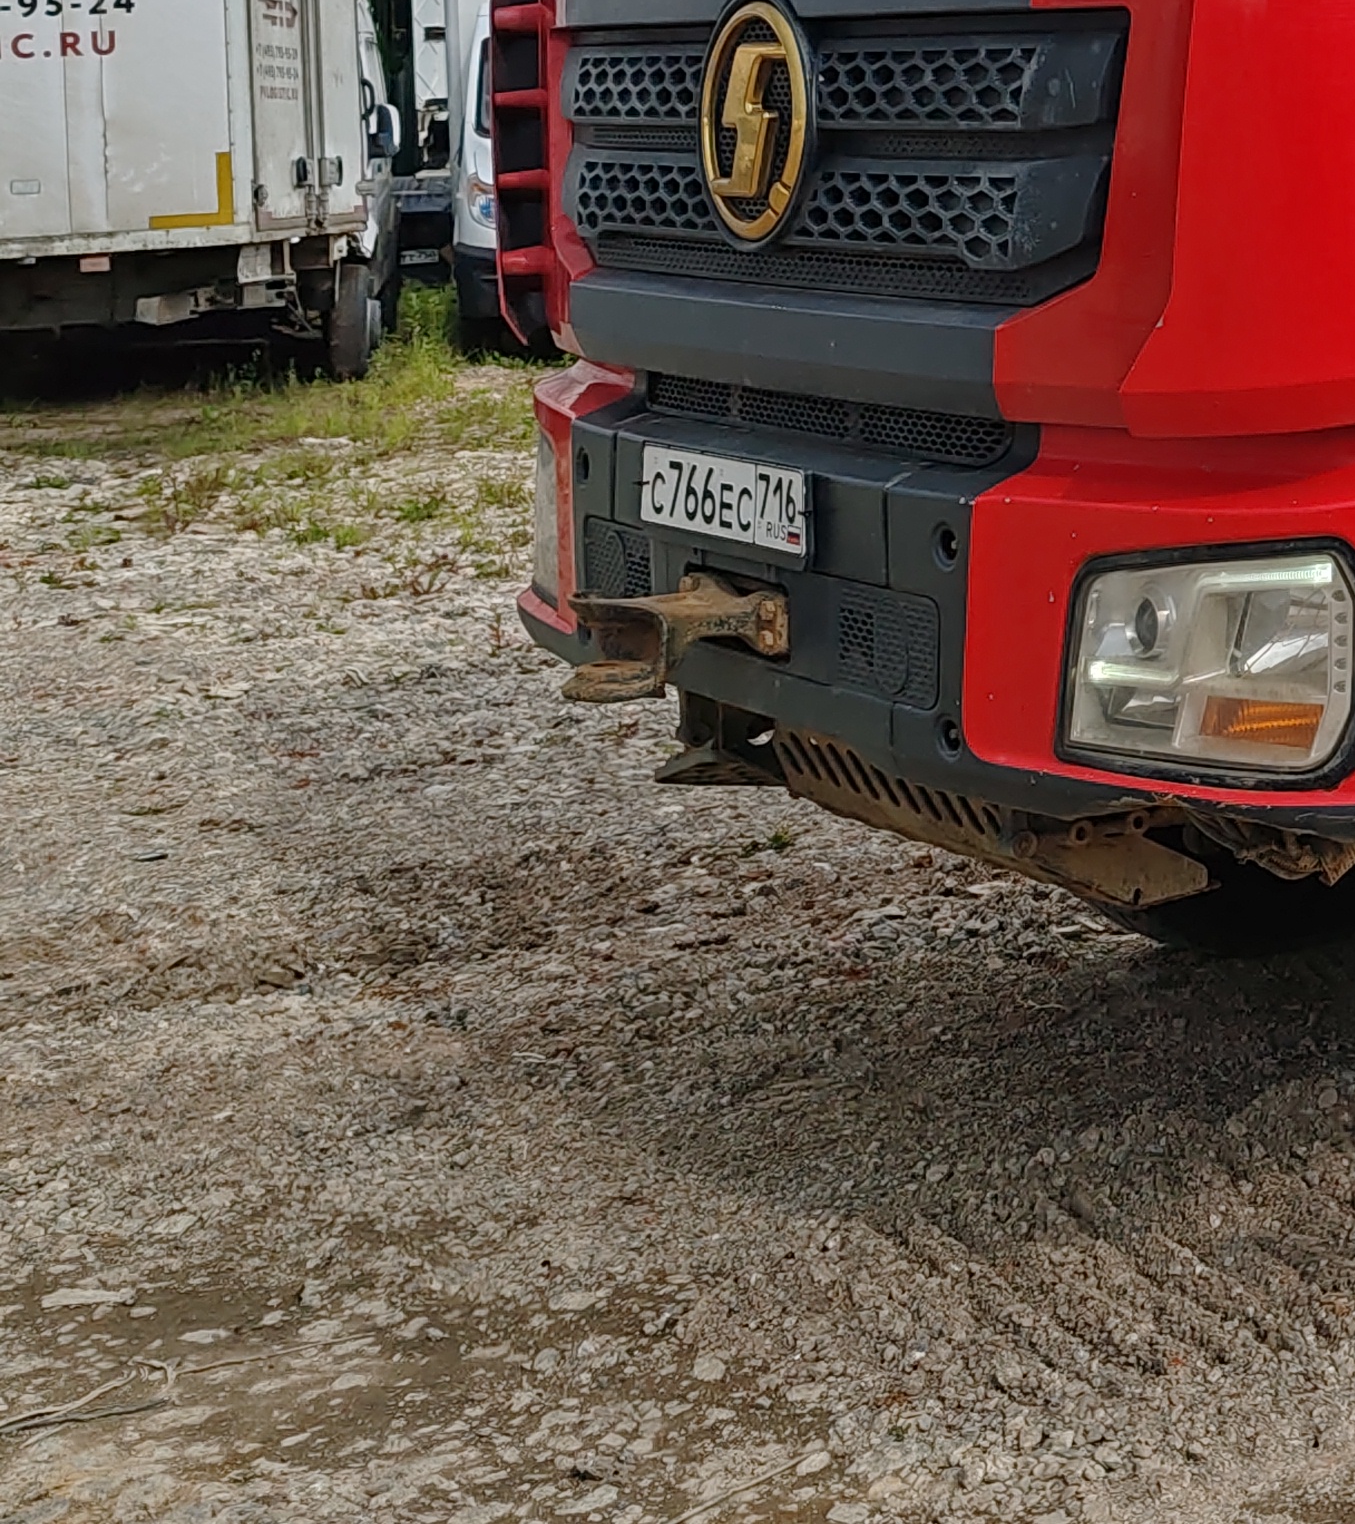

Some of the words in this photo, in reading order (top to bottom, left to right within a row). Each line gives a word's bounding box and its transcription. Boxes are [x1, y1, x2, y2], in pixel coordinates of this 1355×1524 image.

[0, 30, 116, 59] C.RU
[758, 472, 796, 525] 716
[766, 522, 786, 542] RUS
